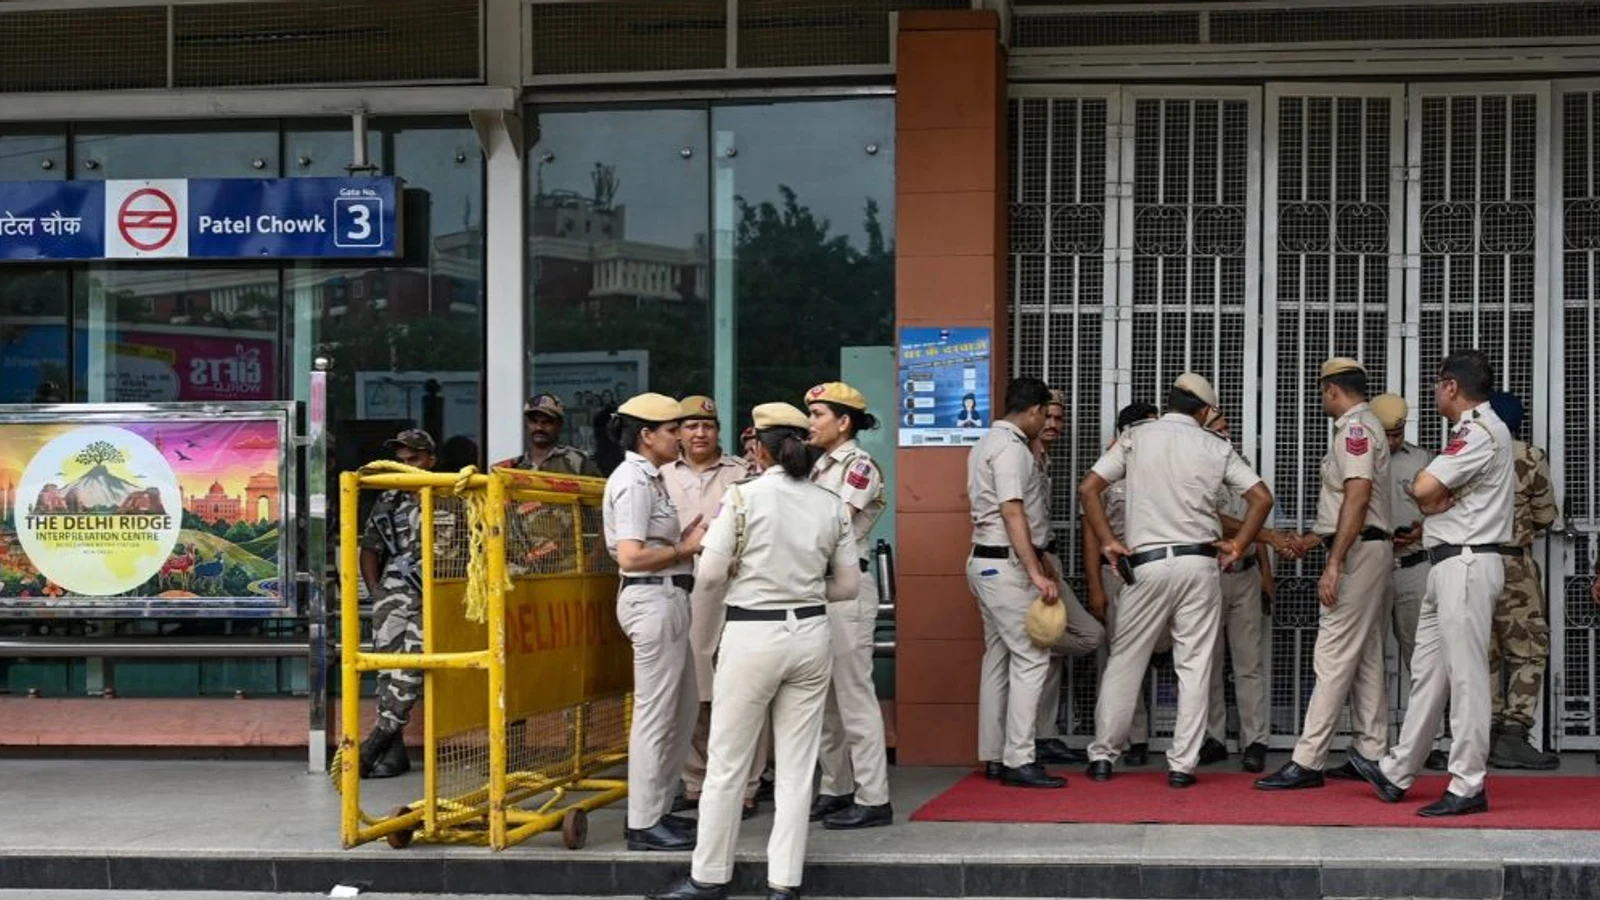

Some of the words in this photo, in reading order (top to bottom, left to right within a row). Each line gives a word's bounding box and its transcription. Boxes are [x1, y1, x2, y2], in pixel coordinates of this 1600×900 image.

[339, 188, 360, 196] Gate
[362, 188, 377, 196] No.
[40, 210, 82, 235] चौक
[199, 215, 251, 234] Patel
[256, 214, 326, 234] Chowk
[347, 204, 371, 240] 3
[25, 516, 58, 530] THE
[63, 516, 113, 530] DELHI
[120, 516, 172, 530] RIDGE
[36, 532, 120, 541] INTERPRETATION
[121, 532, 159, 541] CENTRE
